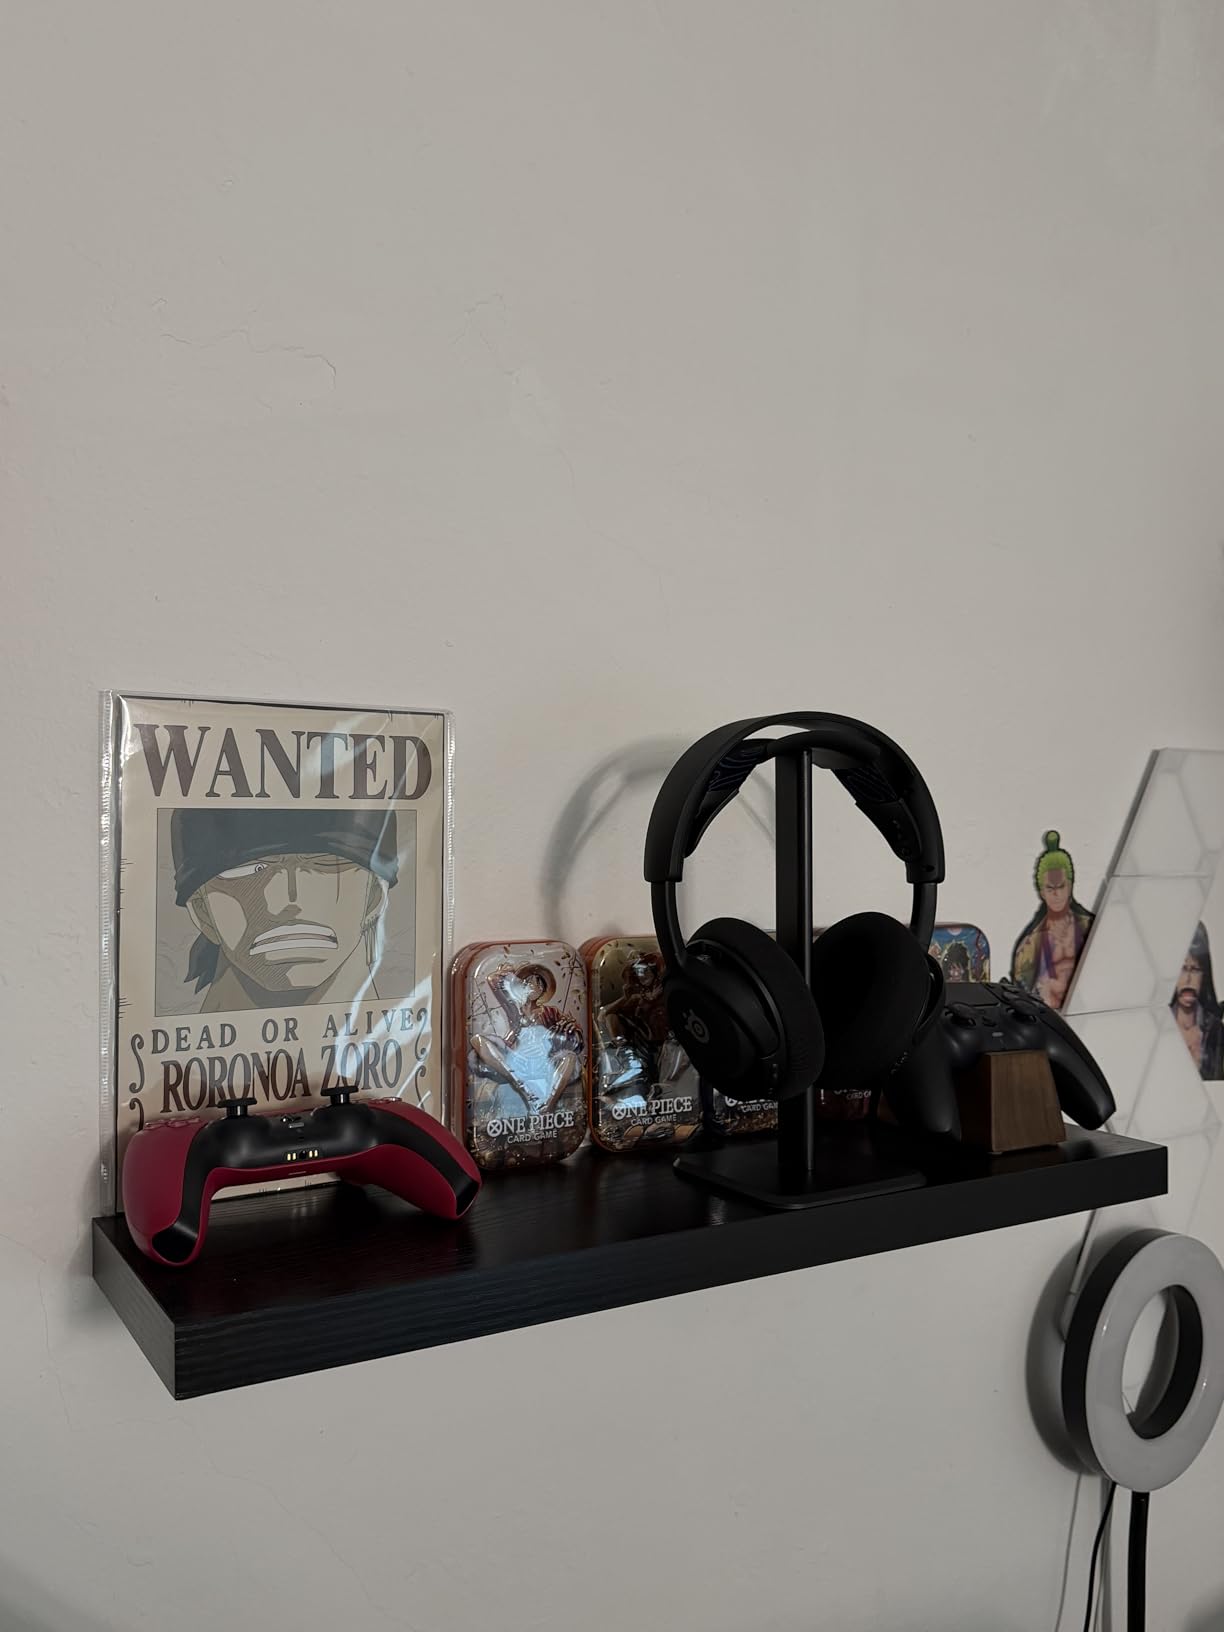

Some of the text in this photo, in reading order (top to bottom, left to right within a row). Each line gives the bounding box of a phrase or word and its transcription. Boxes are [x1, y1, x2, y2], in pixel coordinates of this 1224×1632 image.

[133, 723, 432, 800] WANTED
[151, 1008, 414, 1054] DEAD OR ALIVE
[160, 1039, 404, 1113] RORONOA ZORO
[612, 1096, 693, 1120] ONE PIECE
[630, 1113, 677, 1126] CARD GAME
[487, 1111, 575, 1137] ONE PIECE
[507, 1130, 558, 1144] CARD GAME
